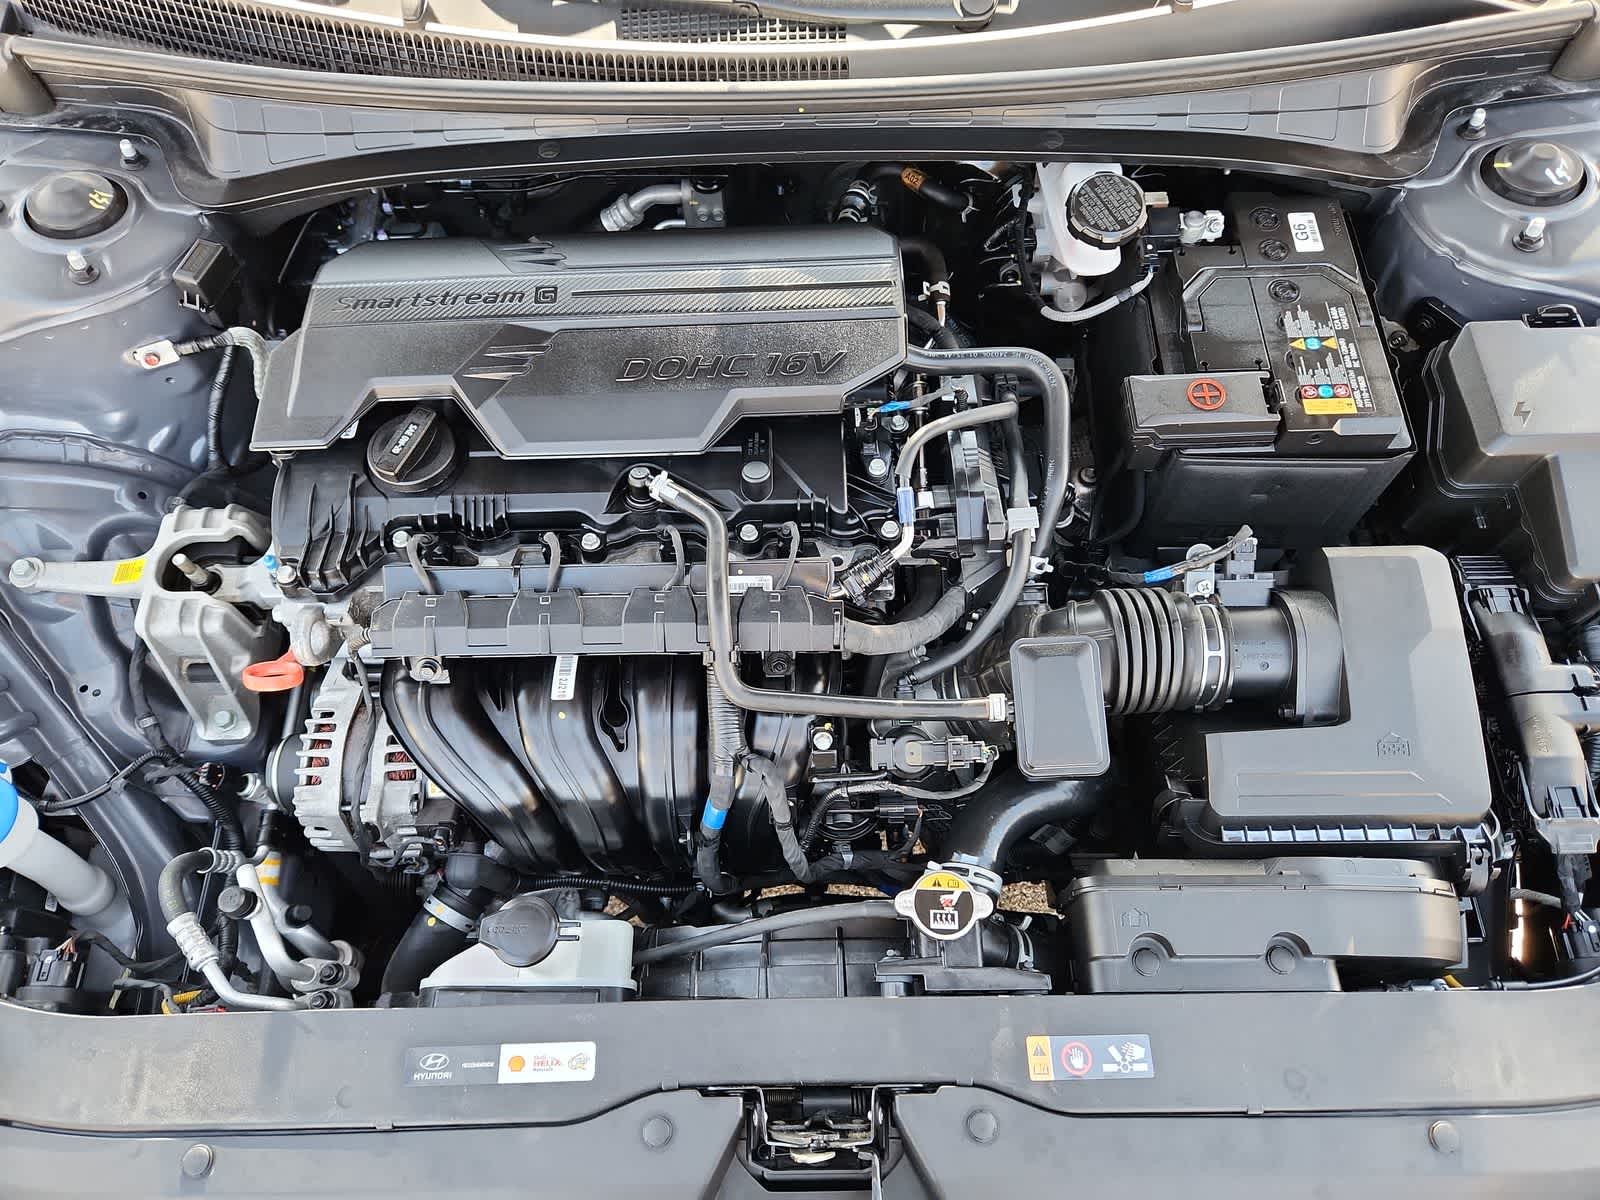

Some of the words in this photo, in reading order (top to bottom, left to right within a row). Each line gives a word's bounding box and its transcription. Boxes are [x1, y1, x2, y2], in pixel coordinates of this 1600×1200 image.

[1293, 223, 1309, 241] G6
[334, 290, 525, 313] Smartstream
[615, 353, 757, 382] DOHC
[765, 350, 847, 378] 16V
[413, 1071, 453, 1081] HYUNDAI
